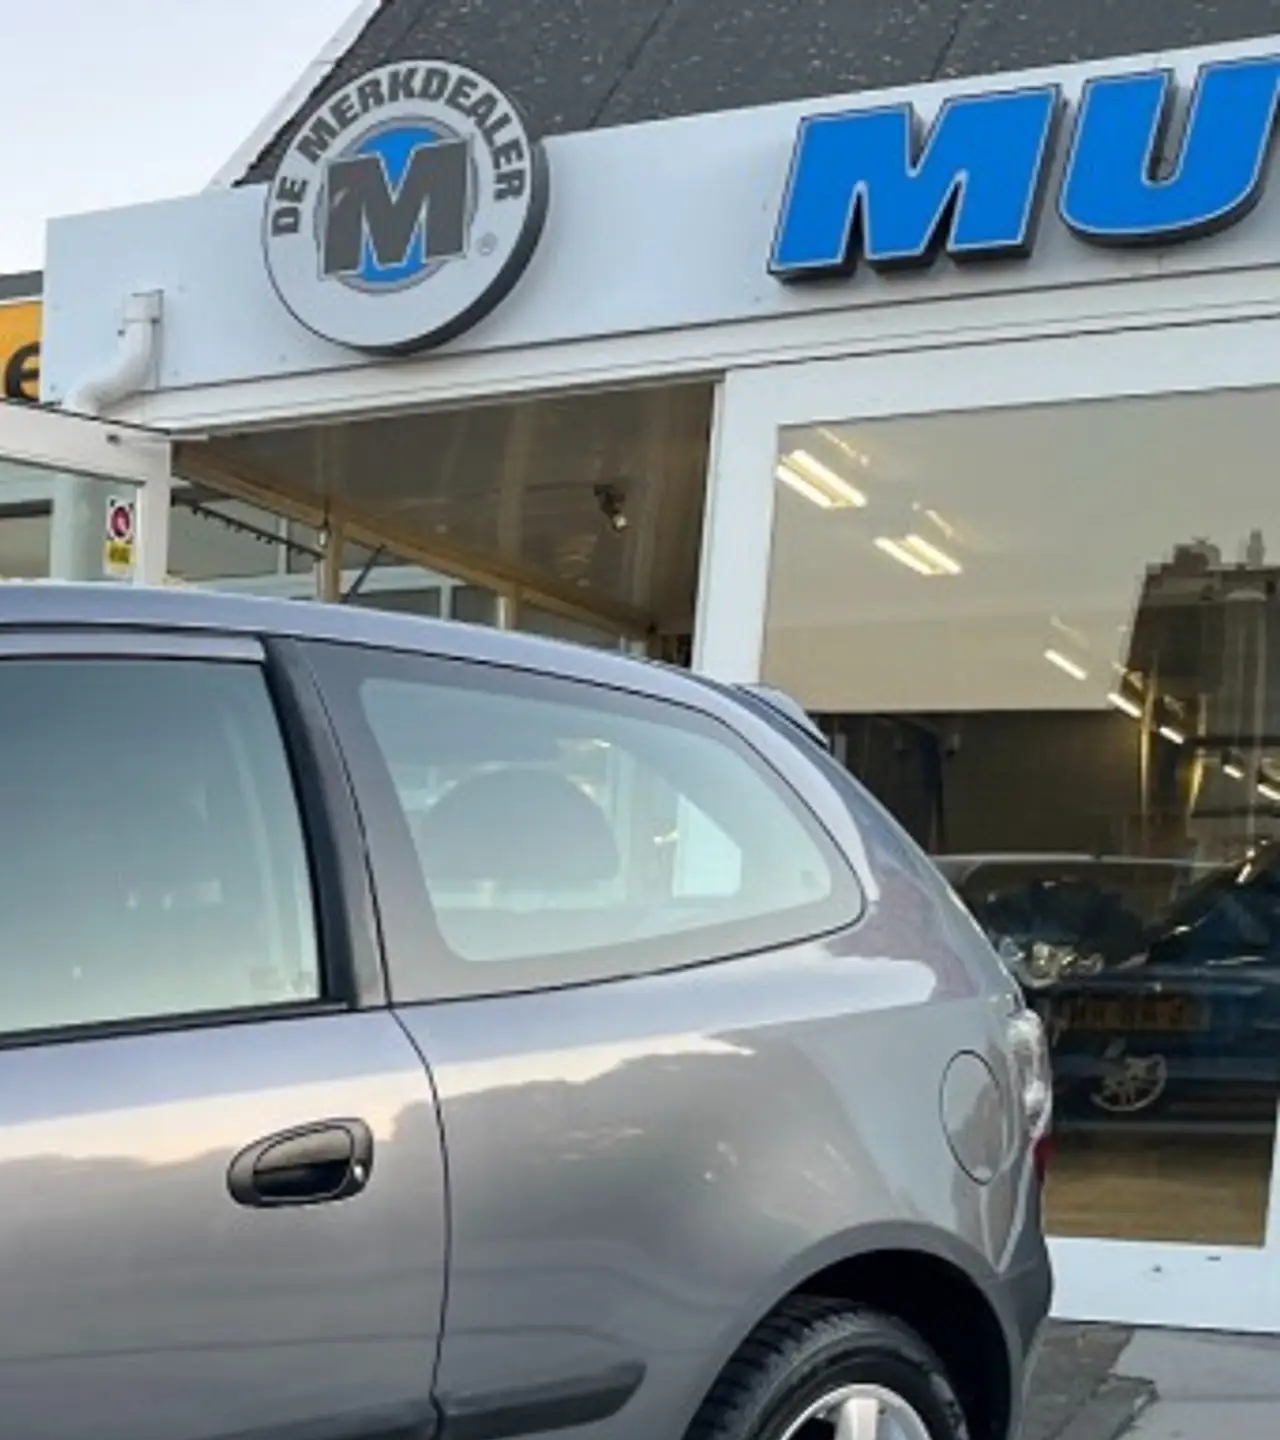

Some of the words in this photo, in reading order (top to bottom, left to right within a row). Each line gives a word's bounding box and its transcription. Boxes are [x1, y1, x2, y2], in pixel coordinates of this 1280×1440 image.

[272, 176, 308, 236] DE
[297, 67, 526, 202] MERKDEALER
[324, 140, 466, 275] M
[768, 54, 1280, 280] MU
